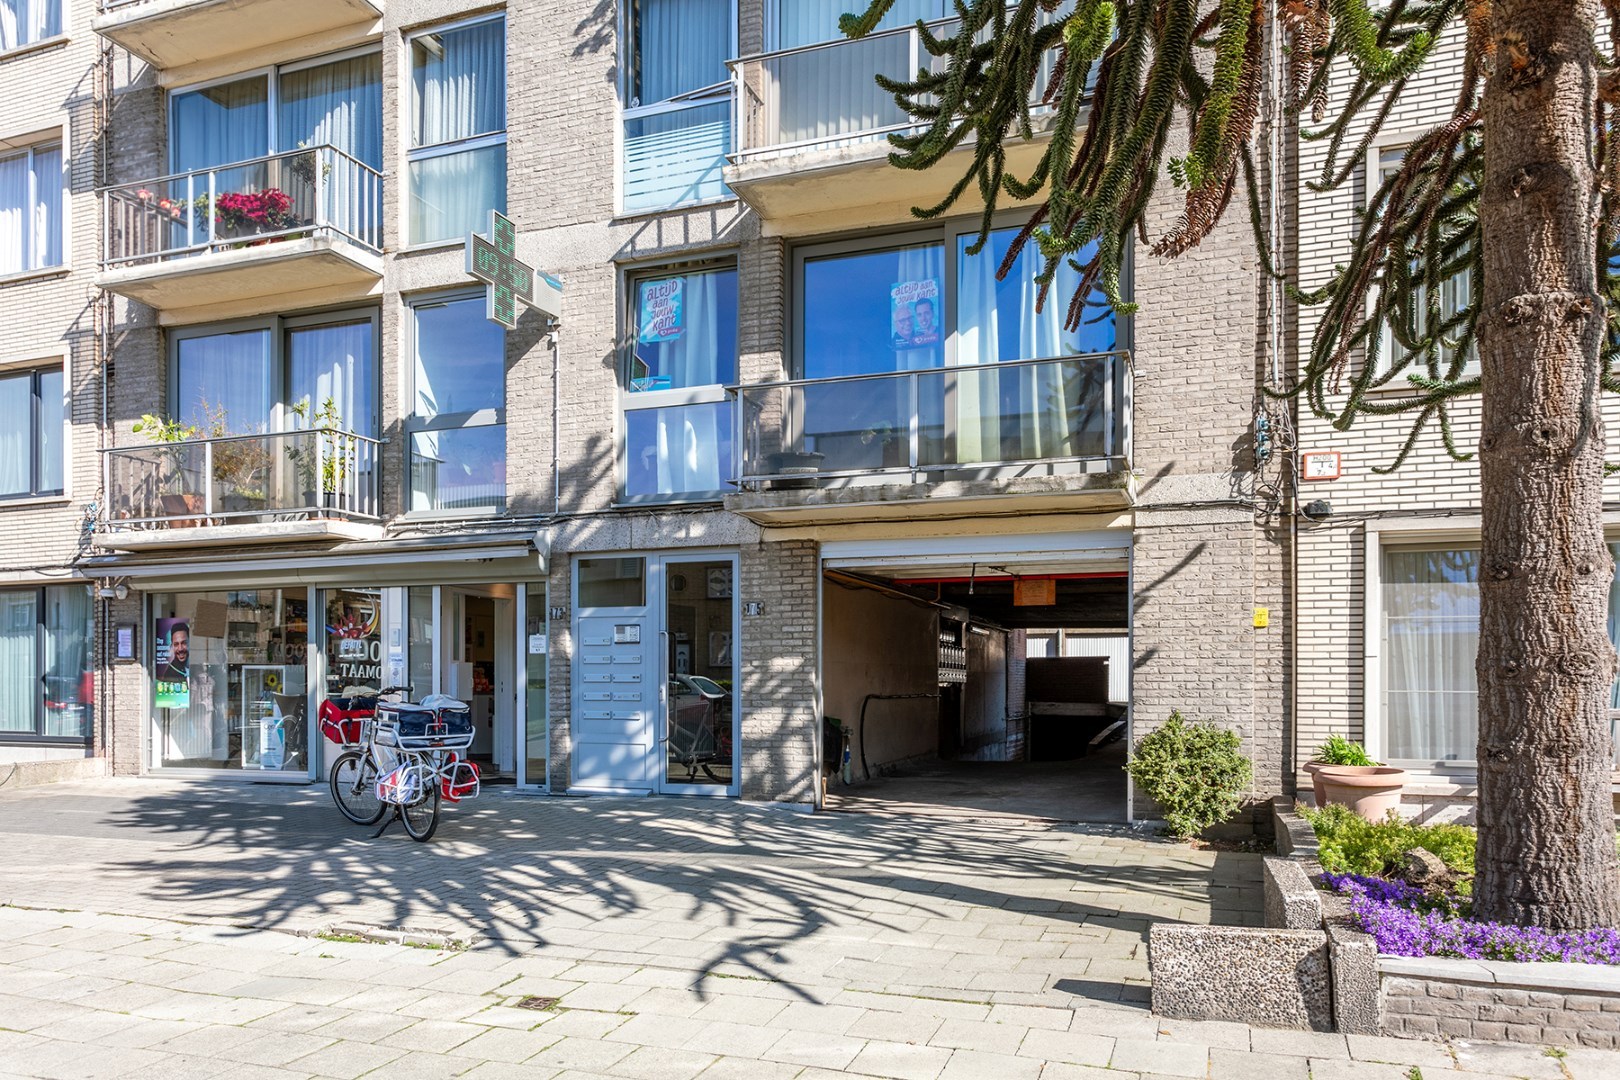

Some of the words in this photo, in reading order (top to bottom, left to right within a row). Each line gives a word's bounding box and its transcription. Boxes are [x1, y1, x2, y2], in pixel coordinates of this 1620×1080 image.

[652, 297, 668, 309] aan
[549, 607, 564, 620] 173
[745, 602, 761, 615] 175
